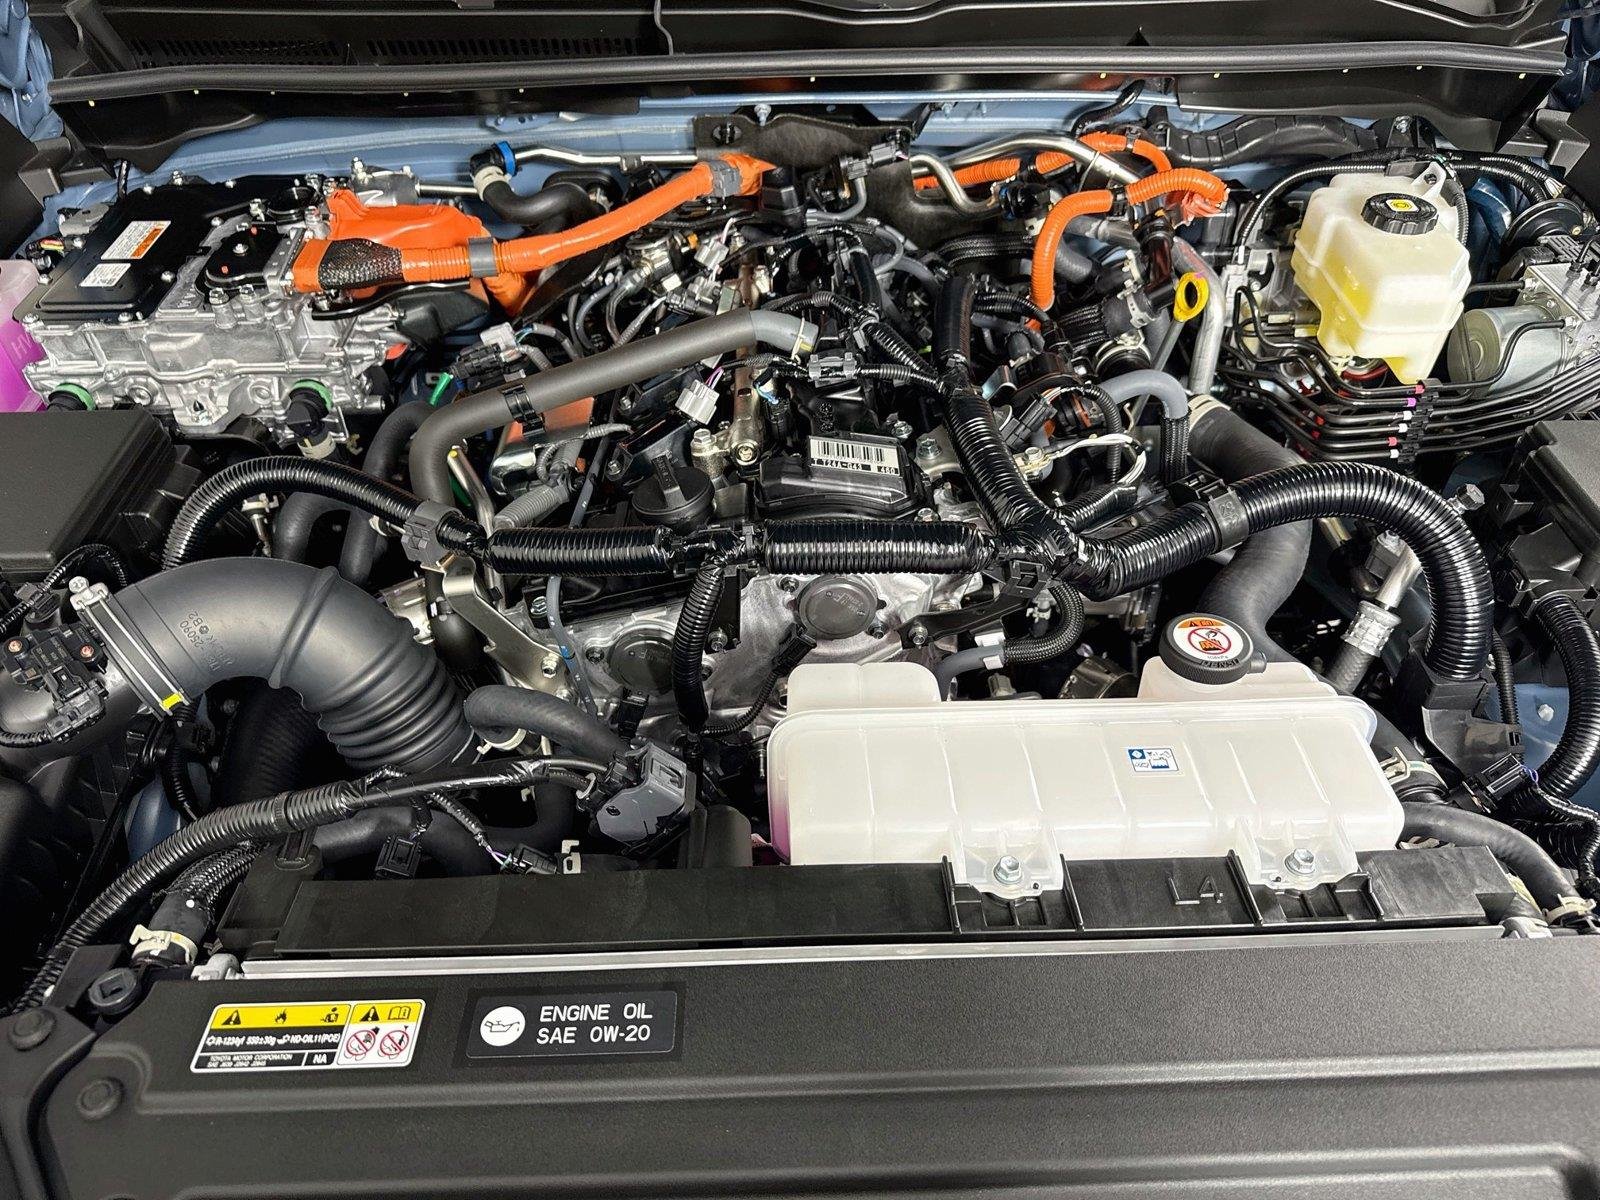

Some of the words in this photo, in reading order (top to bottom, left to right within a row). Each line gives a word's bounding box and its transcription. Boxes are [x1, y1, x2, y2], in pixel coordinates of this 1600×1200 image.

[540, 1004, 611, 1022] ENGINE
[623, 1003, 653, 1020] OIL
[216, 1036, 245, 1047] R-1234yf
[536, 1027, 577, 1044] SAE
[590, 1024, 651, 1042] 0W-20
[313, 1054, 327, 1064] NA
